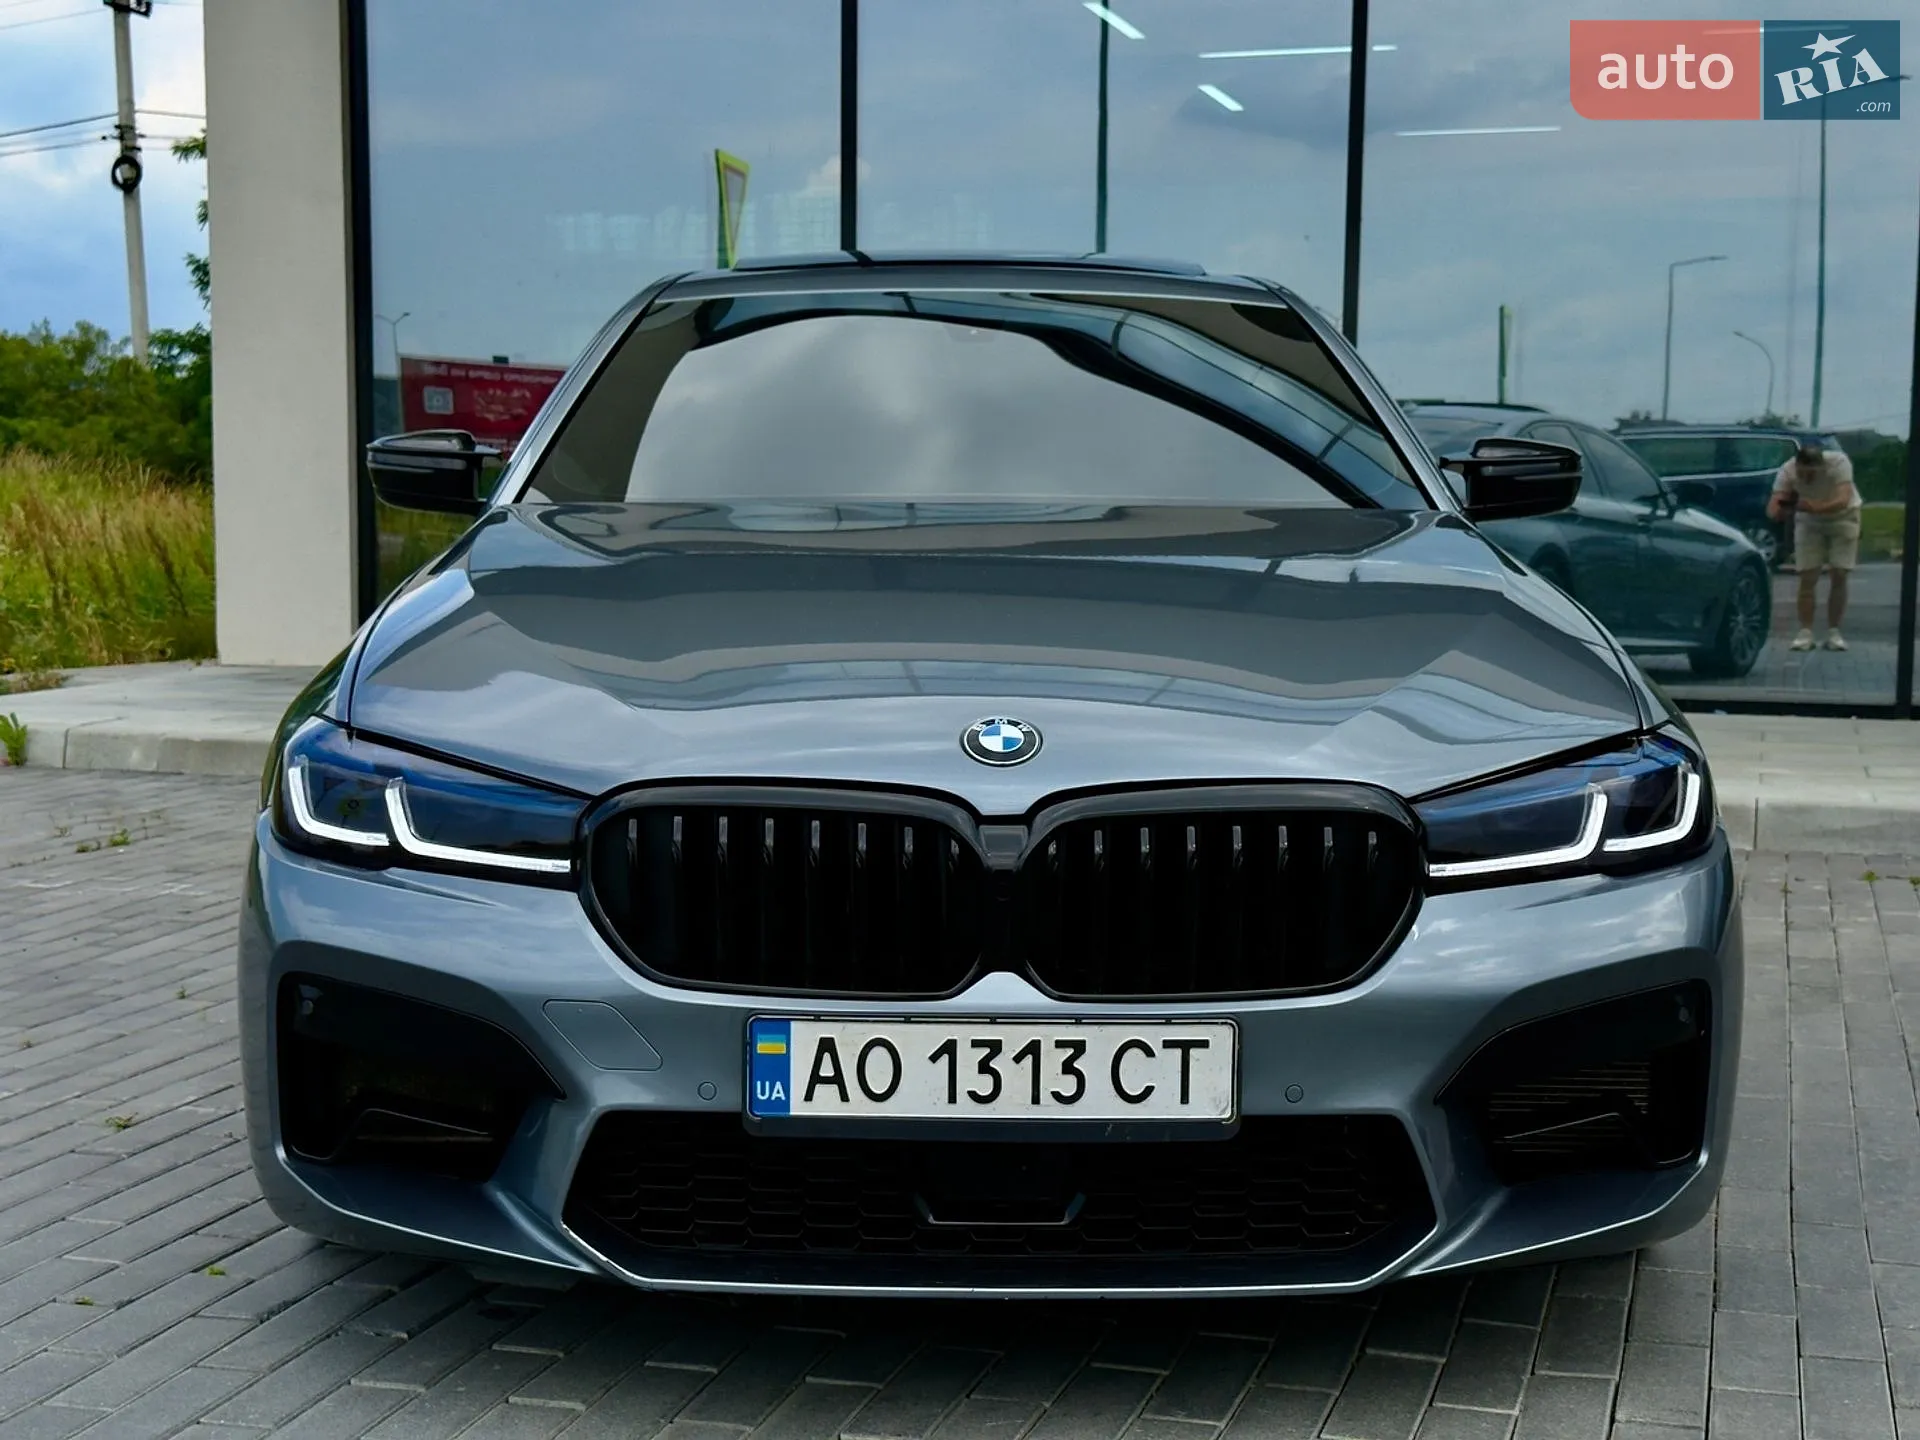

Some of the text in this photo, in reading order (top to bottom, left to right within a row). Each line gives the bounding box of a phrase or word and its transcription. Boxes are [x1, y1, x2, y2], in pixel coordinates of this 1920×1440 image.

[971, 719, 1032, 732] BMW
[927, 1038, 1087, 1105] 1313
[756, 1080, 786, 1101] UA
